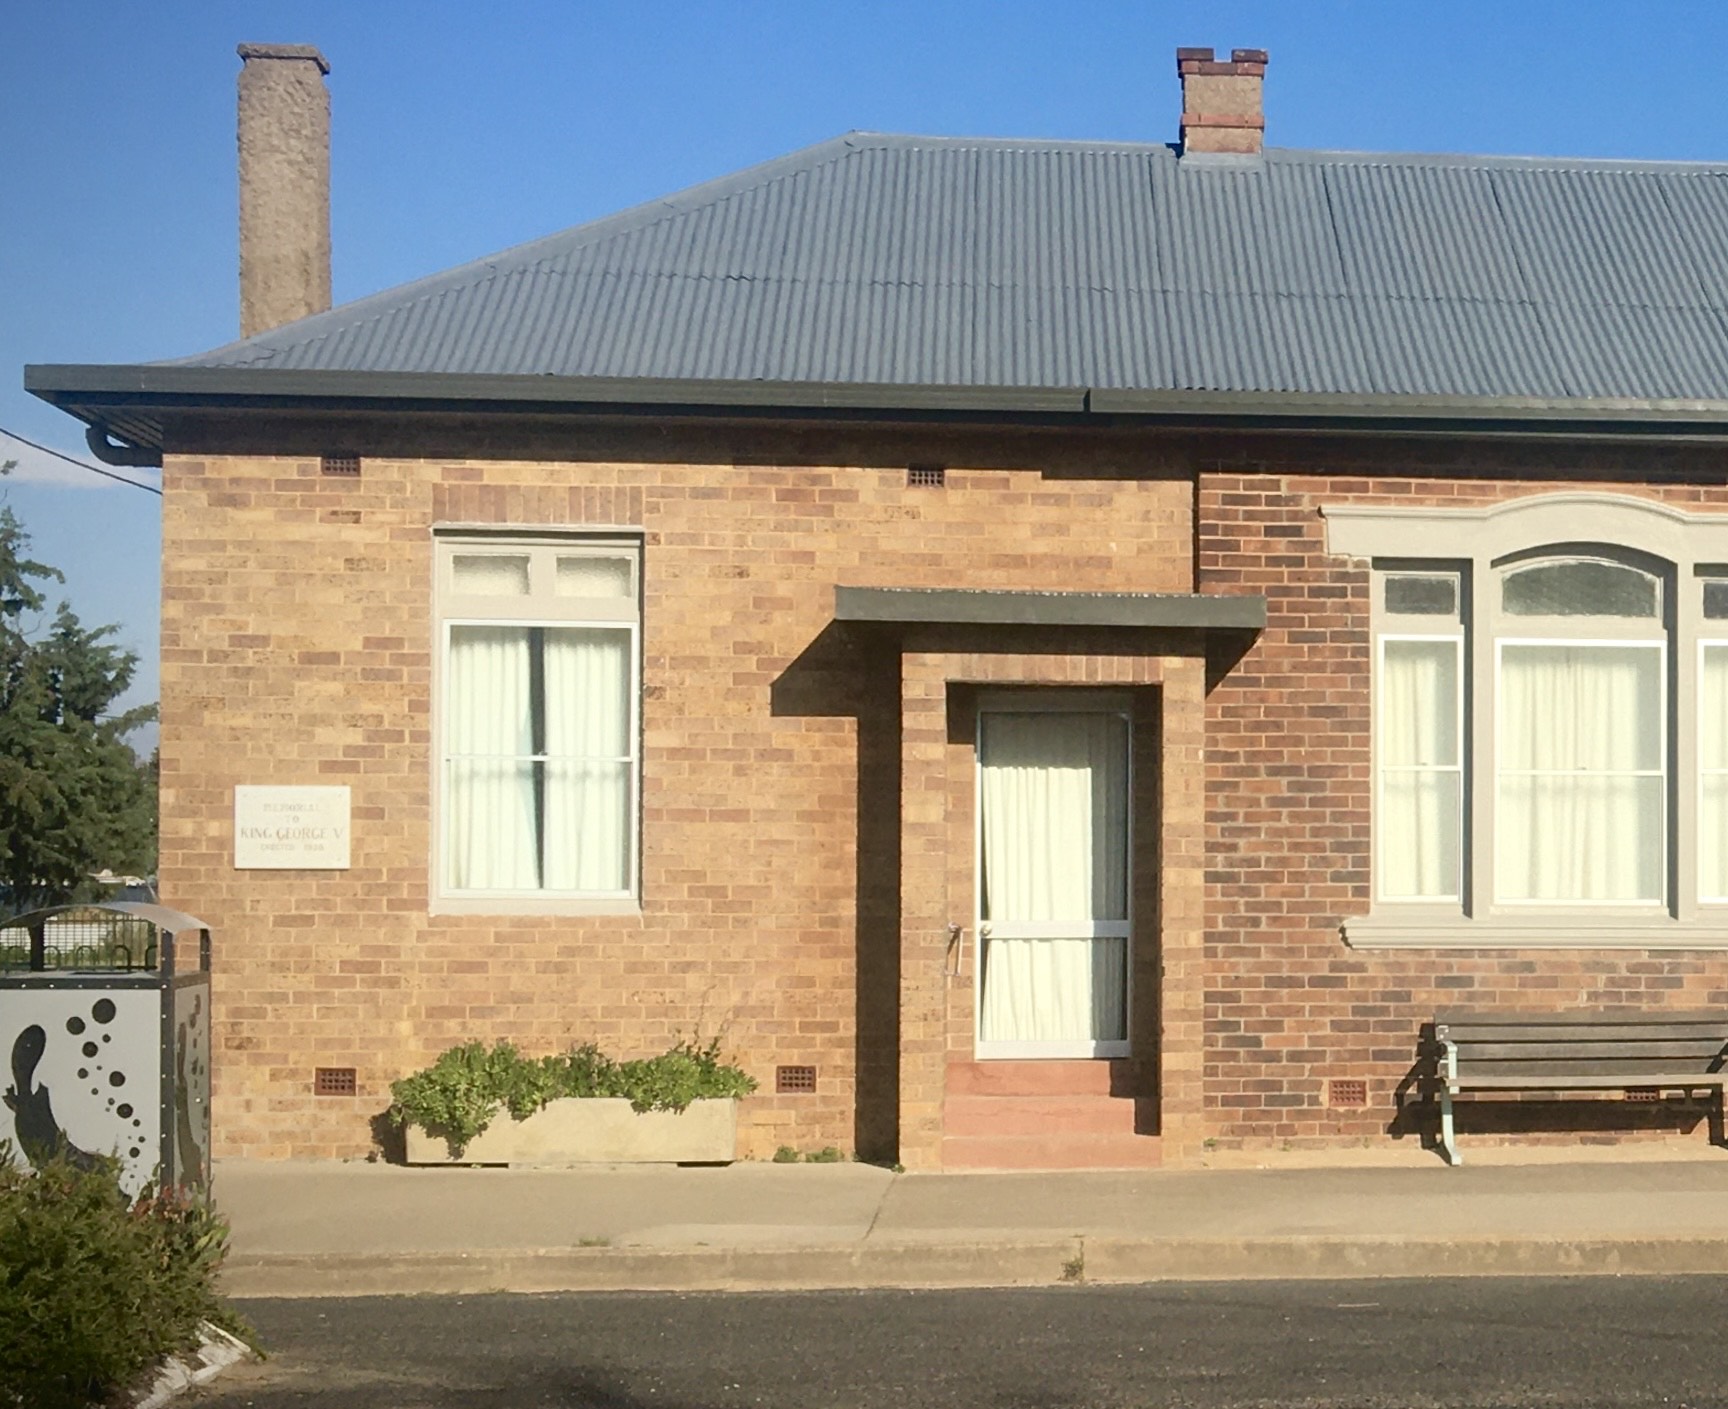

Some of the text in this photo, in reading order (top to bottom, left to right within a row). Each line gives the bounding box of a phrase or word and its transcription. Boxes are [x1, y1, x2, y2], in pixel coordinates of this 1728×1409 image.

[240, 826, 344, 841] KING GEORGE V
